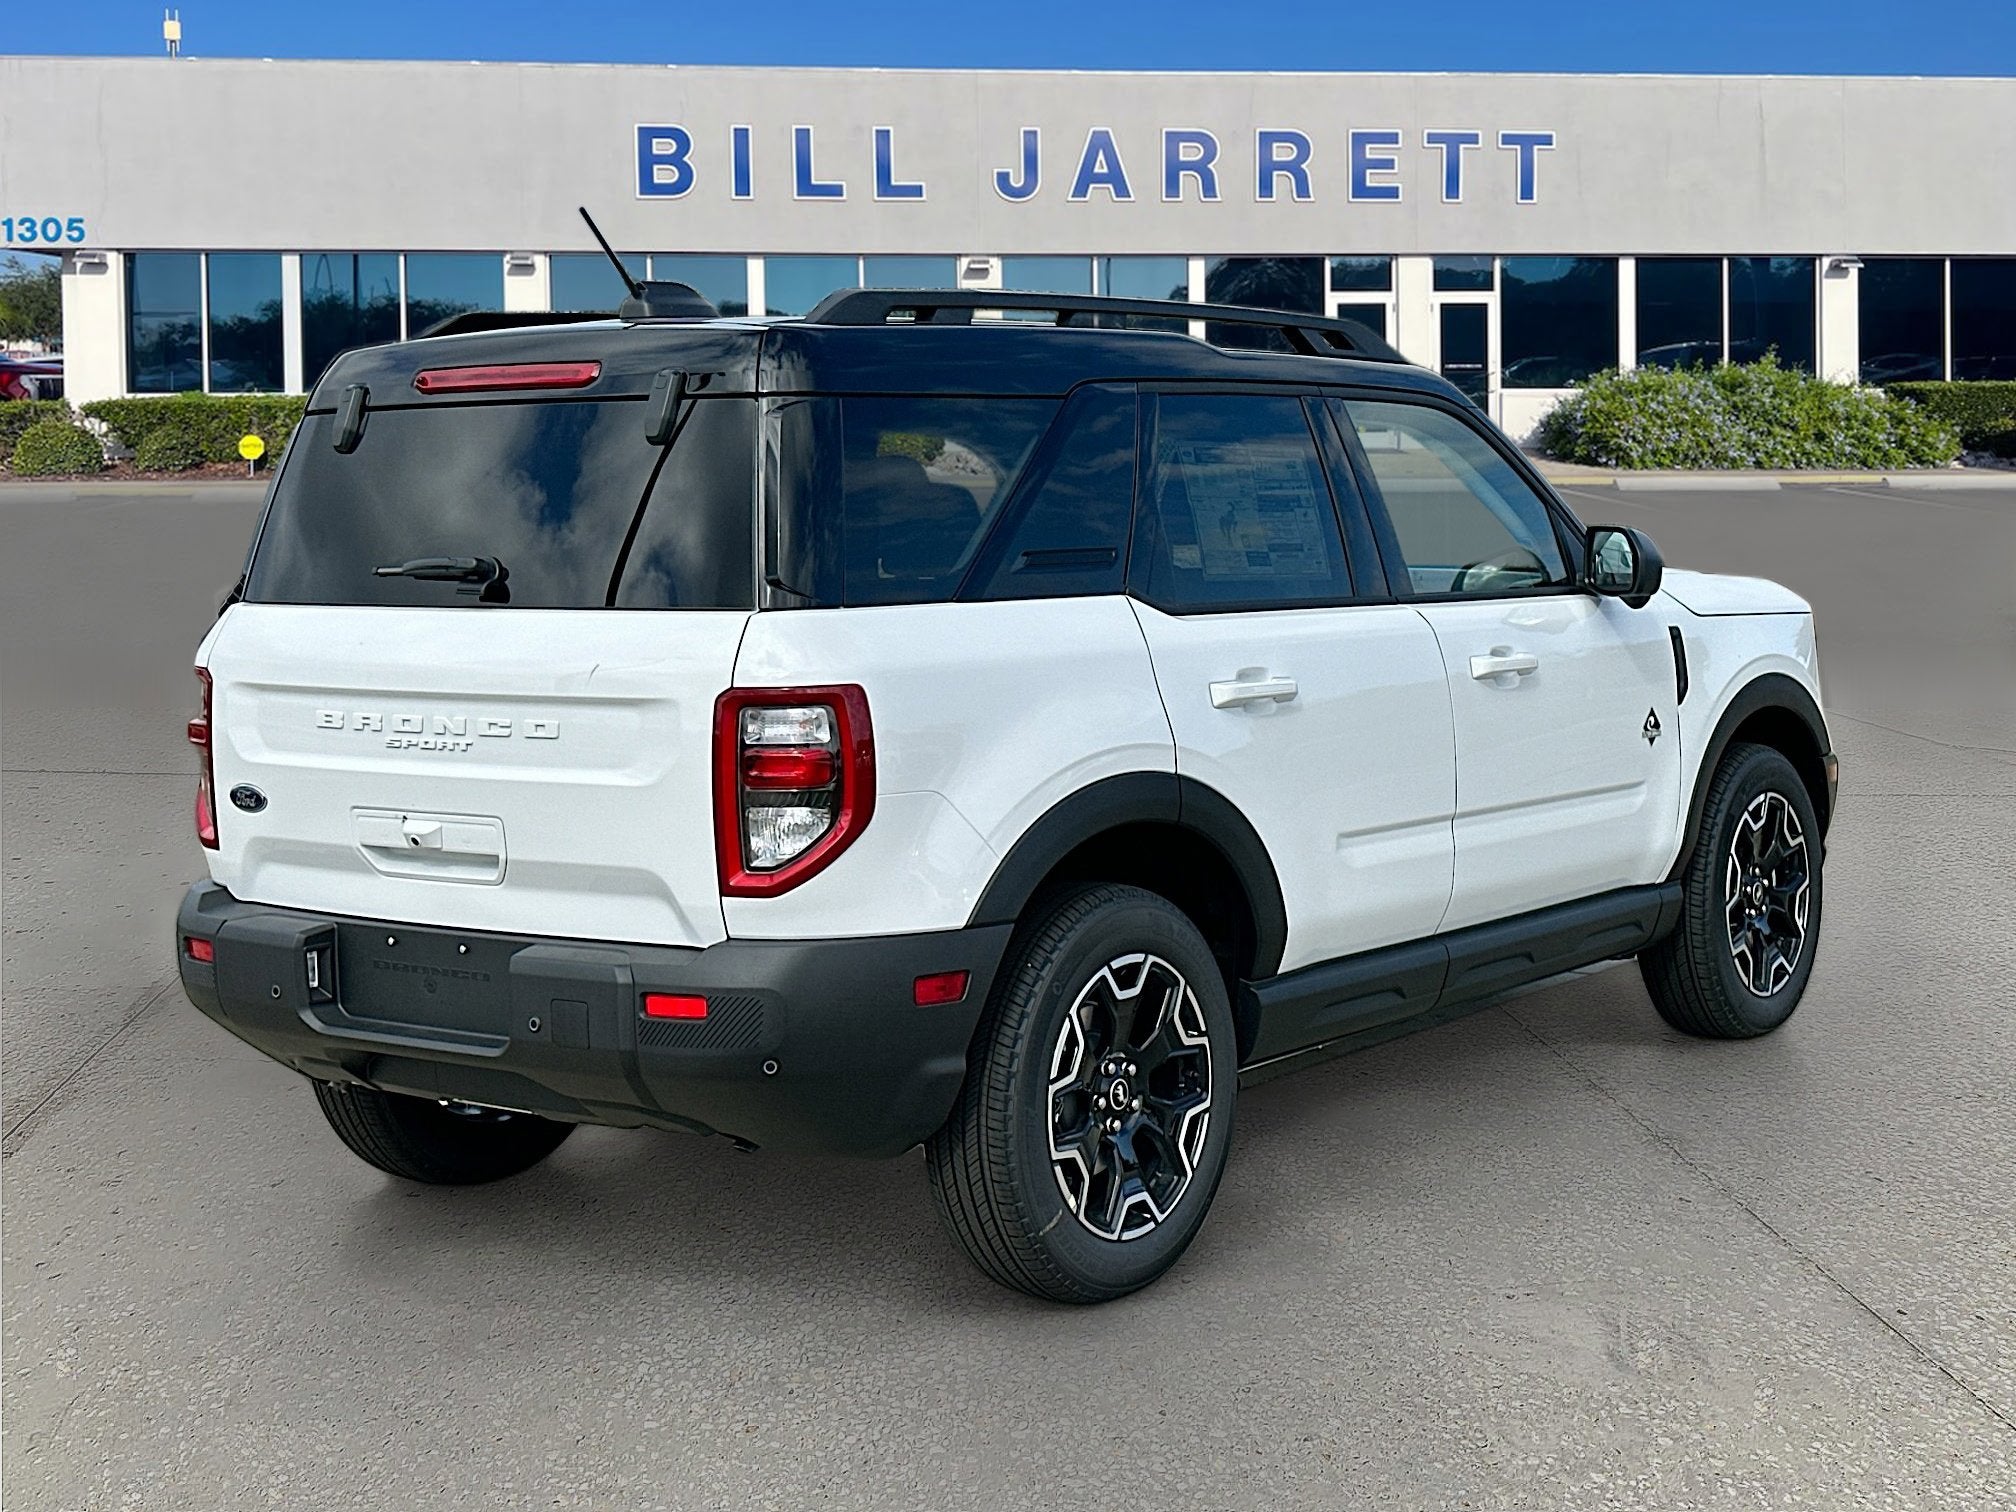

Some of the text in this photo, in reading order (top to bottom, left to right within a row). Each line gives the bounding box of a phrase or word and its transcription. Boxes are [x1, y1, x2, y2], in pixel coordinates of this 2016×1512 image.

[634, 123, 1556, 204] BILL JARRETT
[2, 216, 86, 243] 1305
[315, 709, 561, 740] BRONCO
[384, 736, 474, 752] SPORT
[372, 960, 491, 982] BRONCO
